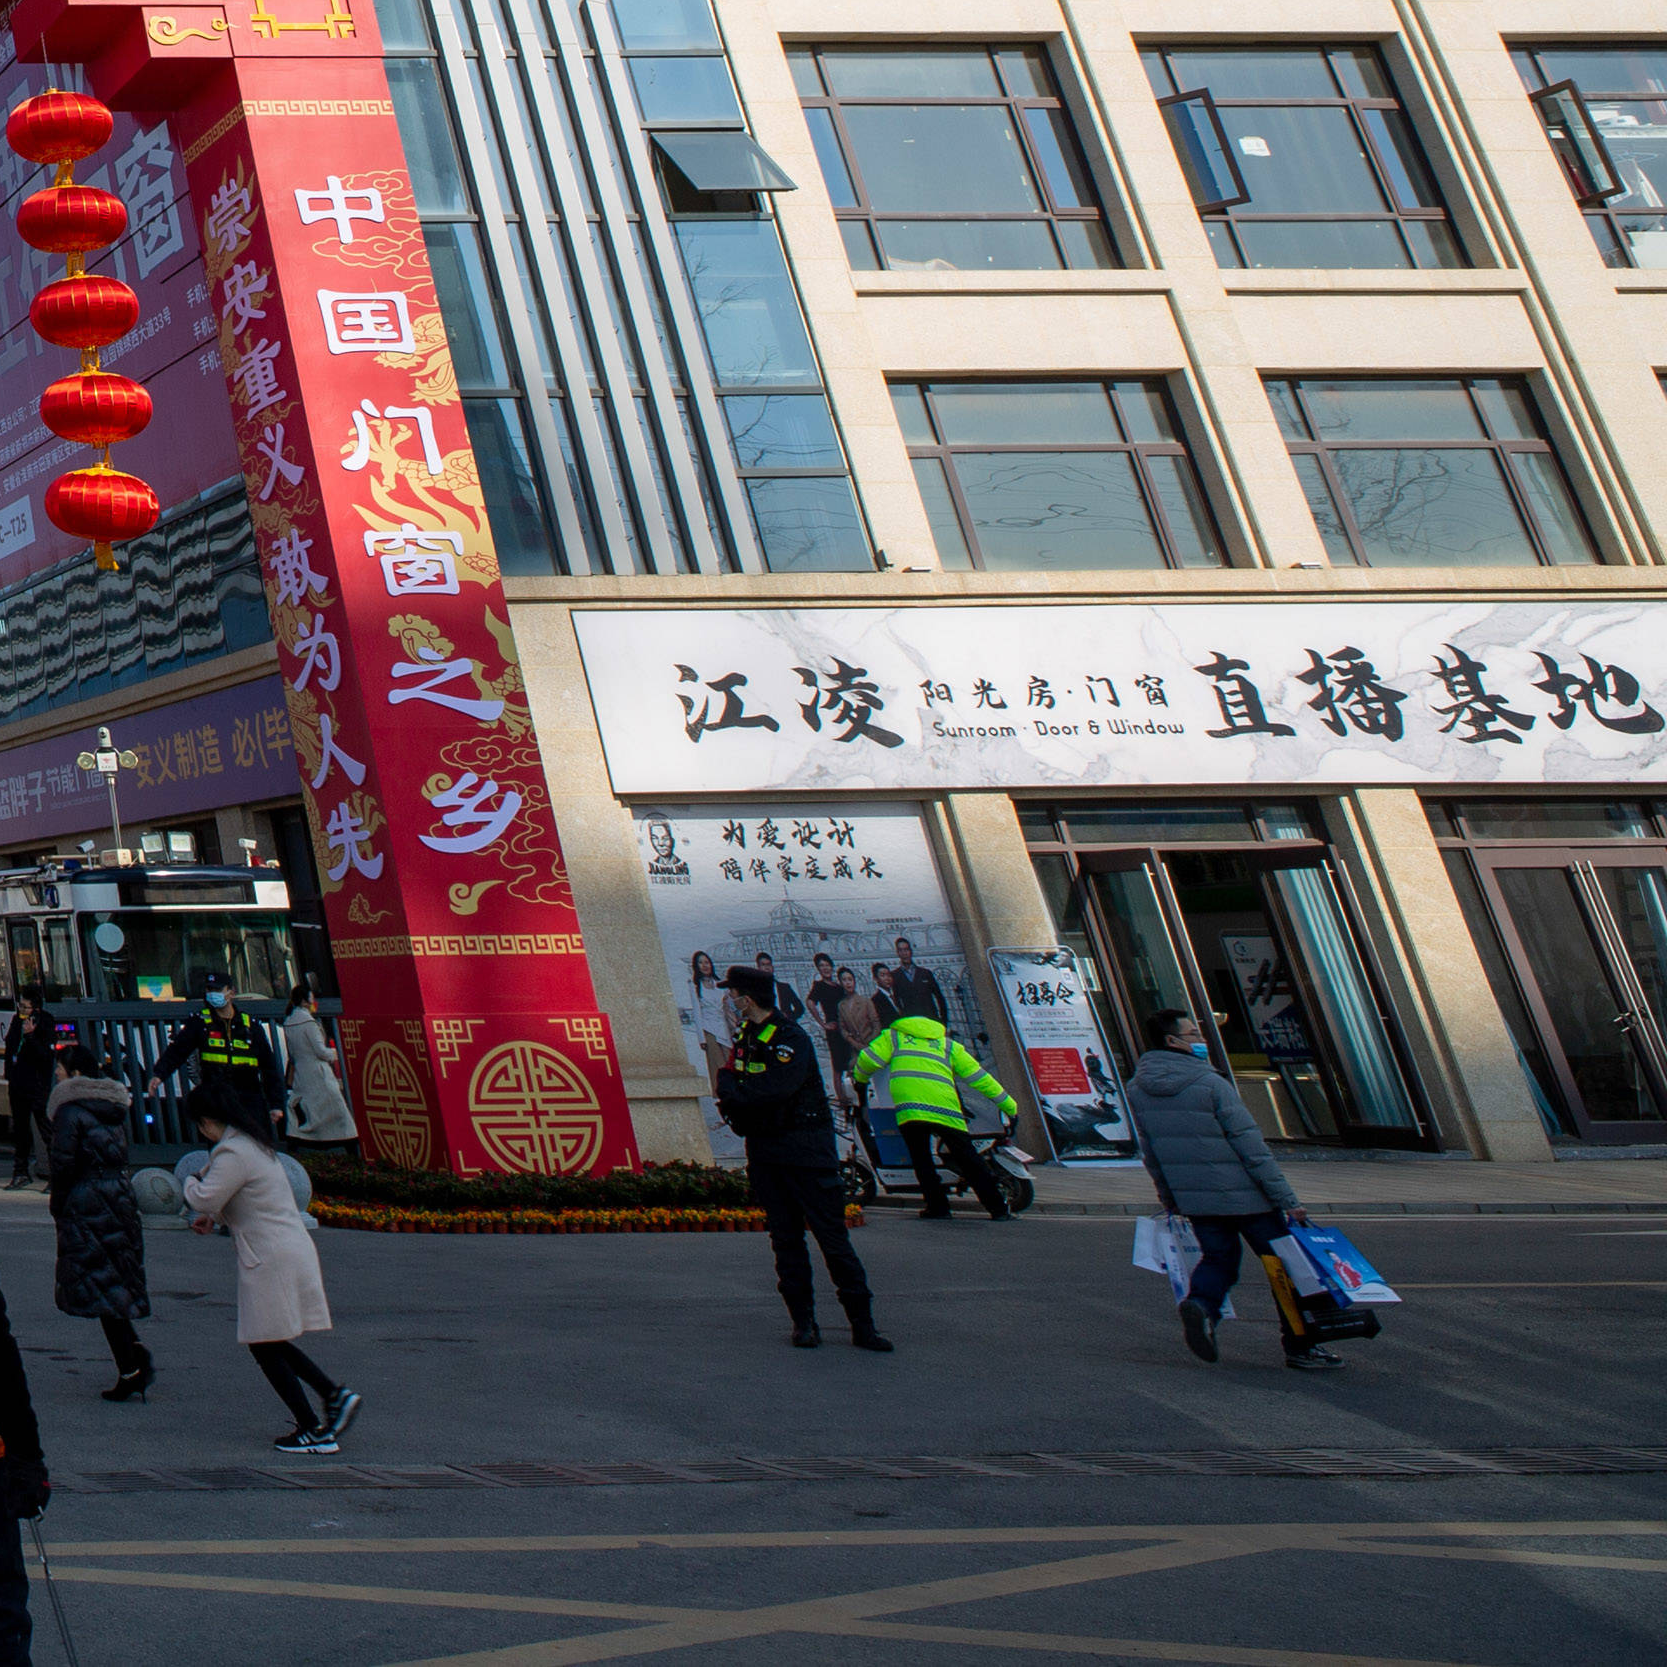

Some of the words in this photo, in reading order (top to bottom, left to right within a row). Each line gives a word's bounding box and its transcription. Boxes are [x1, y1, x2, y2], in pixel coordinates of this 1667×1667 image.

[208, 178, 384, 882] 崇安重义敢为人先
[294, 175, 523, 855] 中国门窗之乡
[675, 654, 905, 750] 江凌
[932, 721, 1017, 738] Sunroom
[1033, 720, 1080, 737] Door
[1088, 719, 1101, 735] &
[1107, 719, 1185, 735] Window
[1192, 644, 1665, 744] 直播基地
[134, 724, 224, 790] 安义制造
[718, 854, 884, 883] 陪伴家庭成长
[722, 816, 855, 851] 为爱设计
